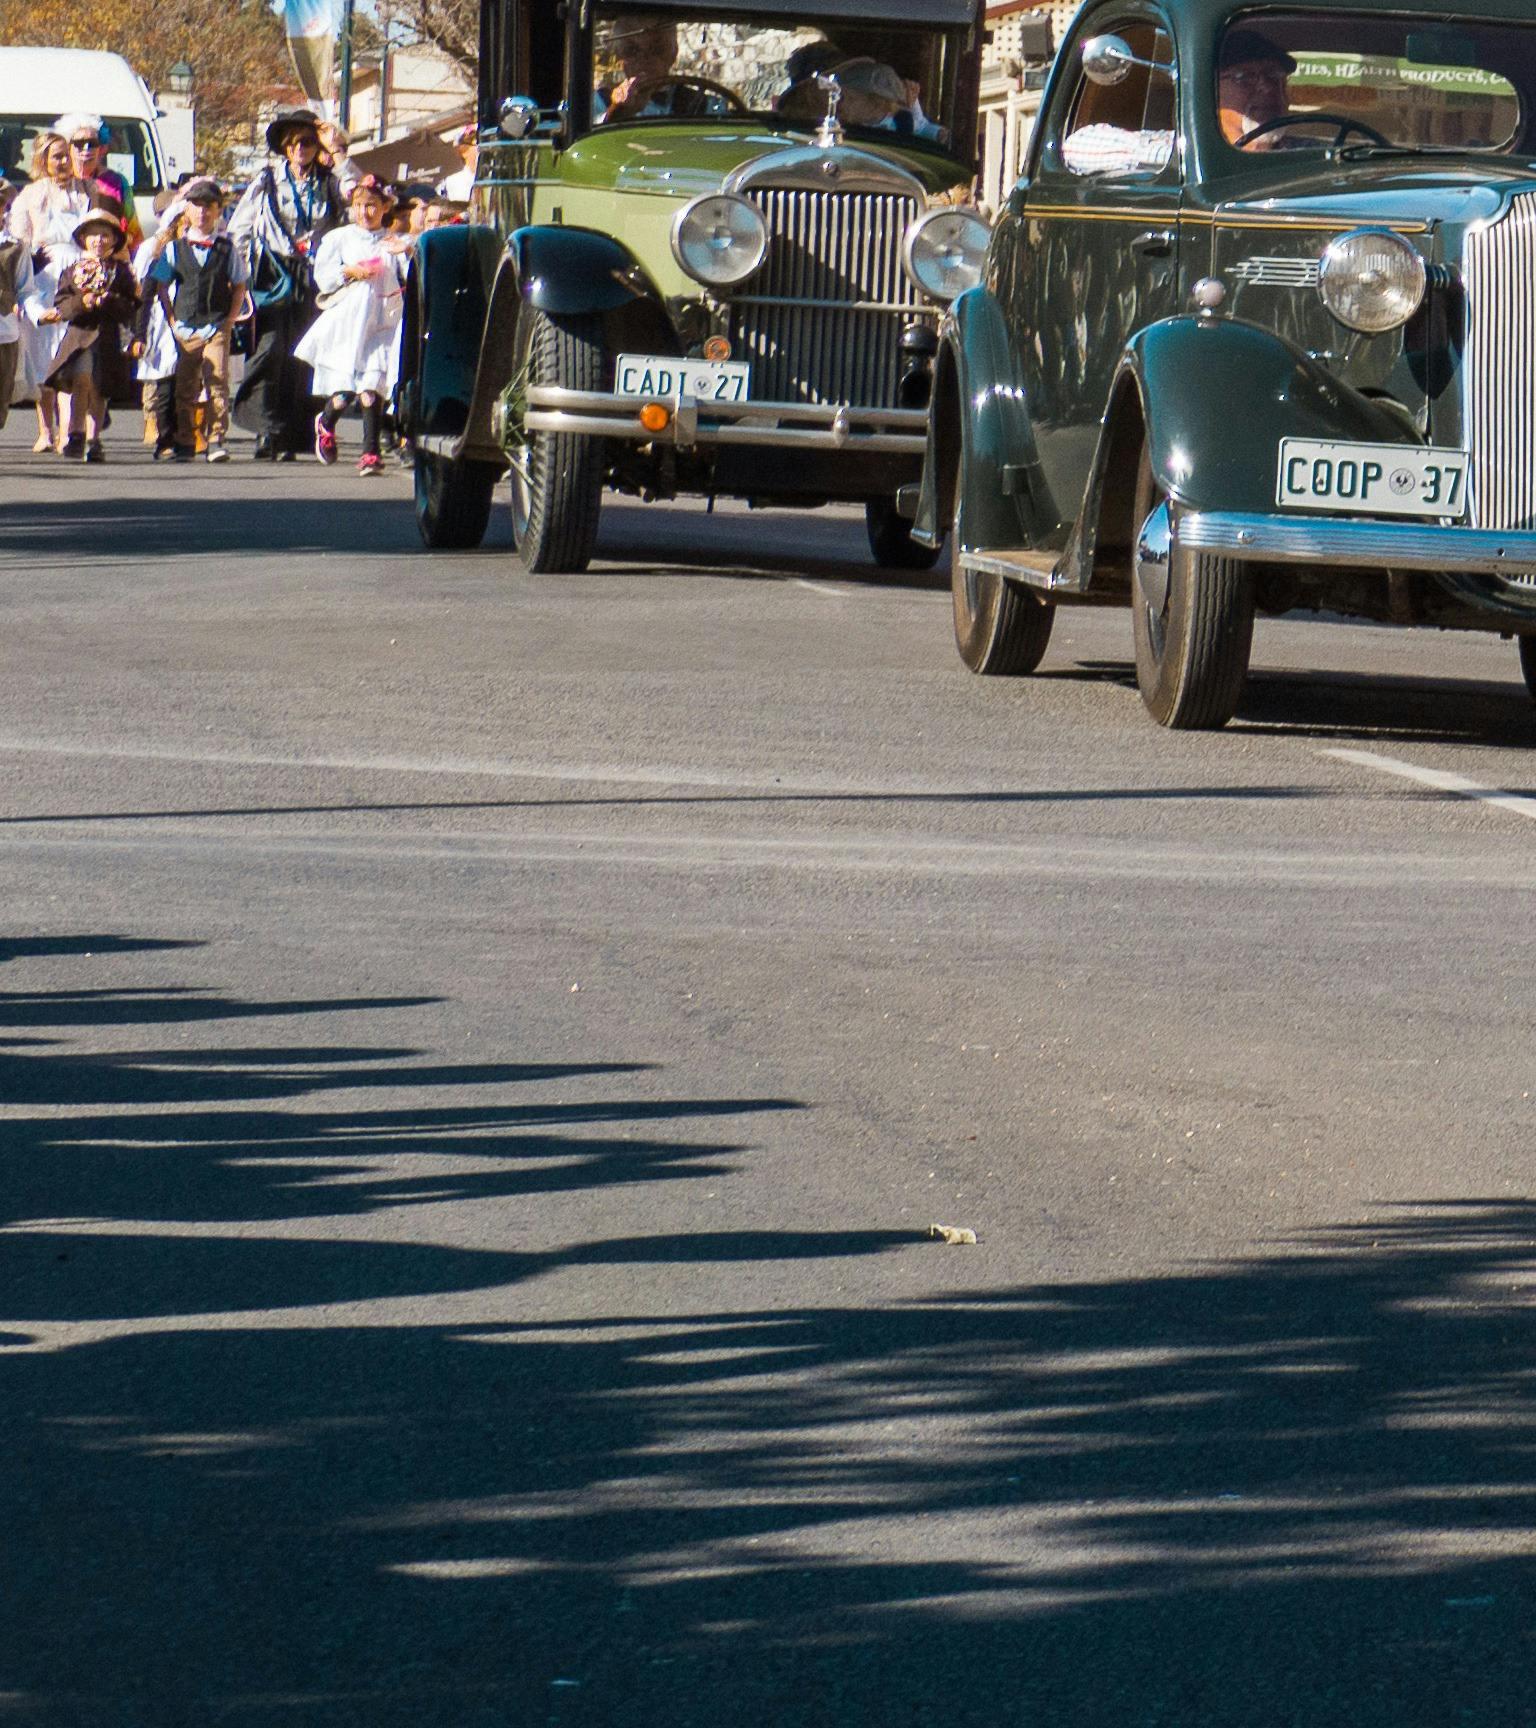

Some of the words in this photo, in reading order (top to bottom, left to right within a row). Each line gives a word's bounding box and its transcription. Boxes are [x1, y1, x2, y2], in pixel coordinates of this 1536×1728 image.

[715, 375, 744, 401] 27
[1287, 457, 1383, 499] COOP
[1422, 466, 1462, 504] 37
